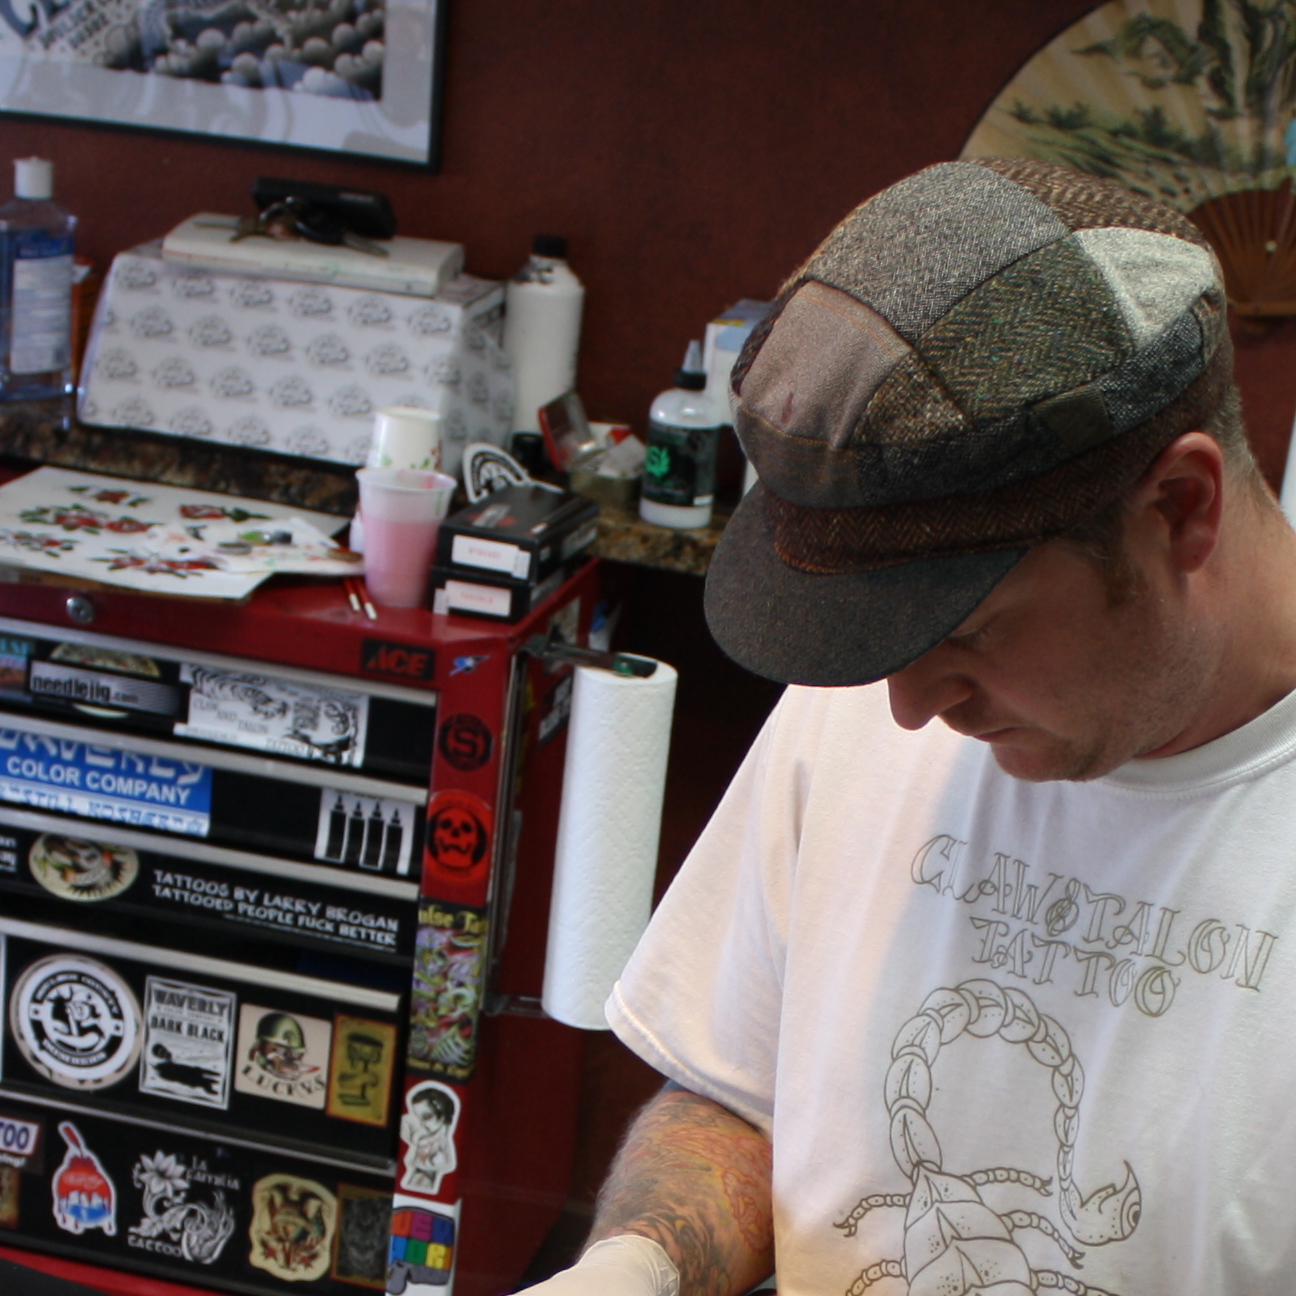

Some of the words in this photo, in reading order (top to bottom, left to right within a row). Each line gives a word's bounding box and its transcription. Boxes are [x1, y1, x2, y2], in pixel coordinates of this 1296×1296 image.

[365, 646, 428, 677] ACE
[6, 755, 81, 788] COLOR
[85, 770, 191, 806] COMPANY
[152, 884, 234, 911] TATTOOED
[237, 901, 294, 926] PEOPLE
[297, 914, 336, 934] FUCK
[339, 923, 397, 946] BETTER
[154, 869, 229, 897] TATTOOS
[233, 886, 259, 903] BY
[263, 892, 322, 916] LARRY
[326, 905, 400, 933] BROGAN
[969, 915, 1181, 1018] TATTOO
[153, 988, 228, 1016] WAVERLY
[151, 1015, 181, 1035] DARK
[186, 1023, 224, 1042] BLACK
